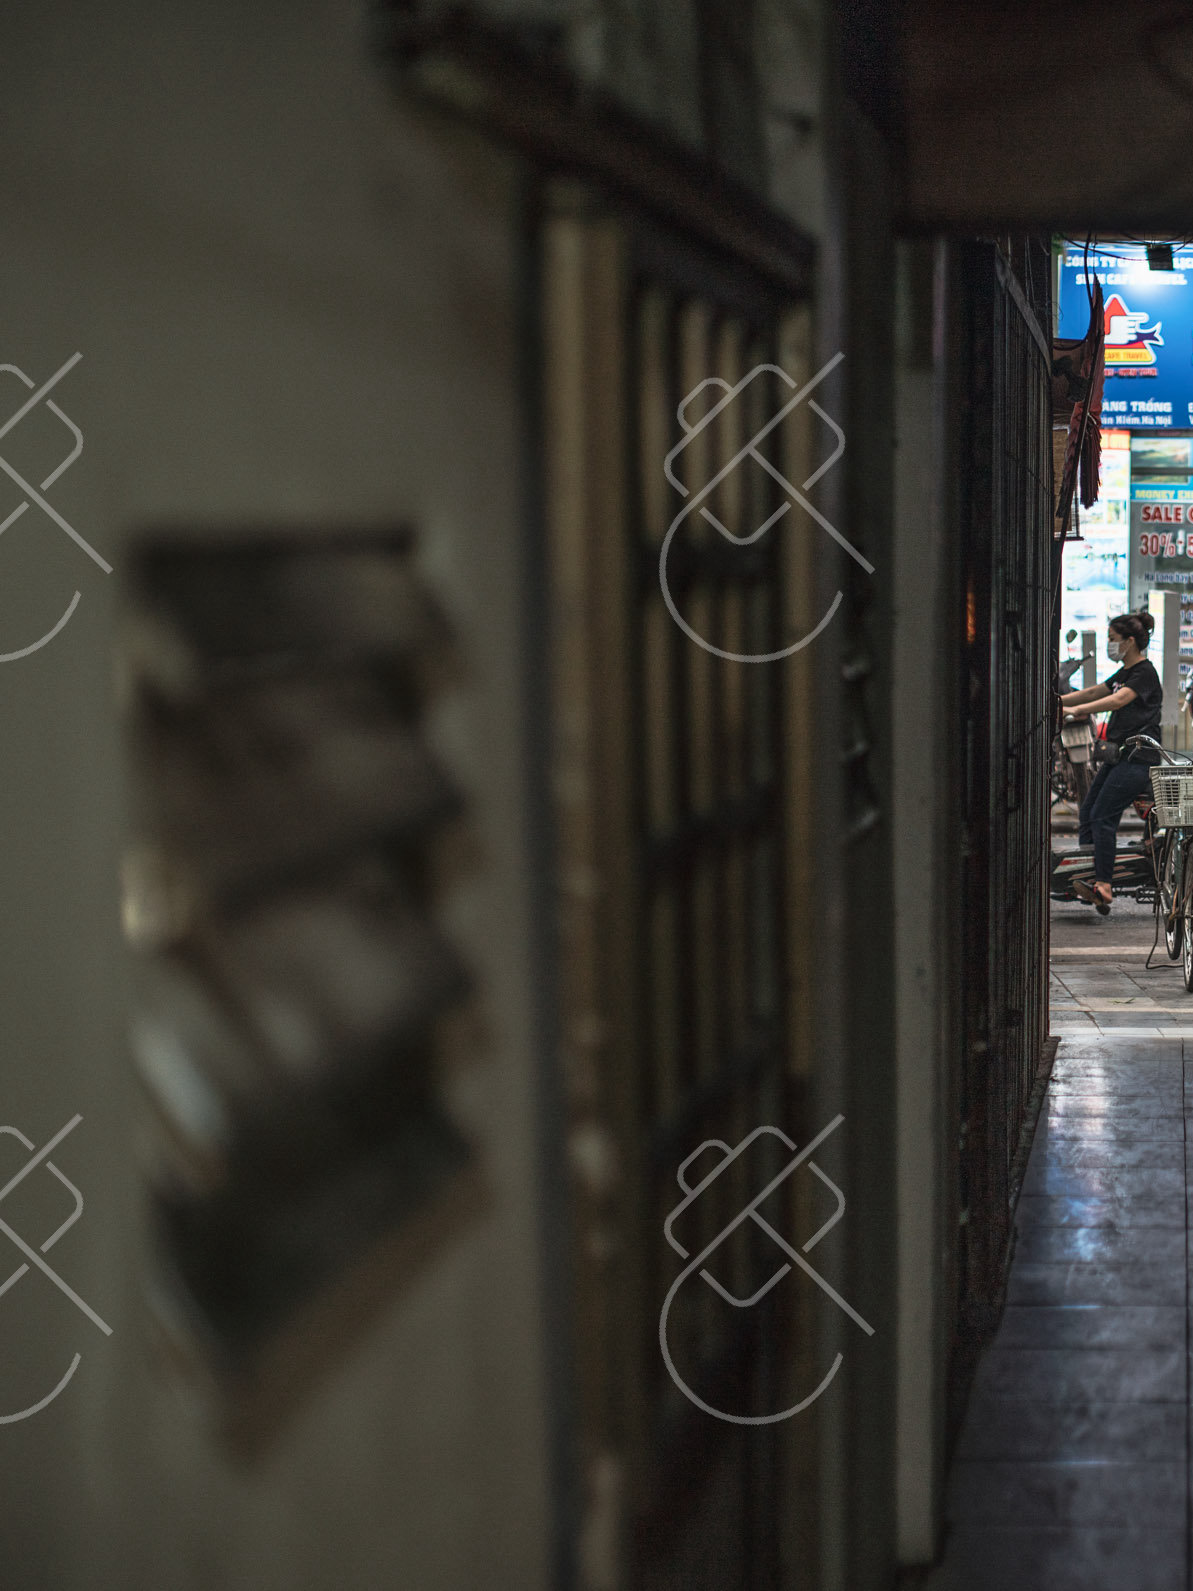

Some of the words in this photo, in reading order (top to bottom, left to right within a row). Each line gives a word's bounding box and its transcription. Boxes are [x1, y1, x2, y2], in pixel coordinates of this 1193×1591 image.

[1102, 399, 1127, 412] ÀNG
[1141, 505, 1183, 523] SALE
[1139, 533, 1176, 557] 30%
